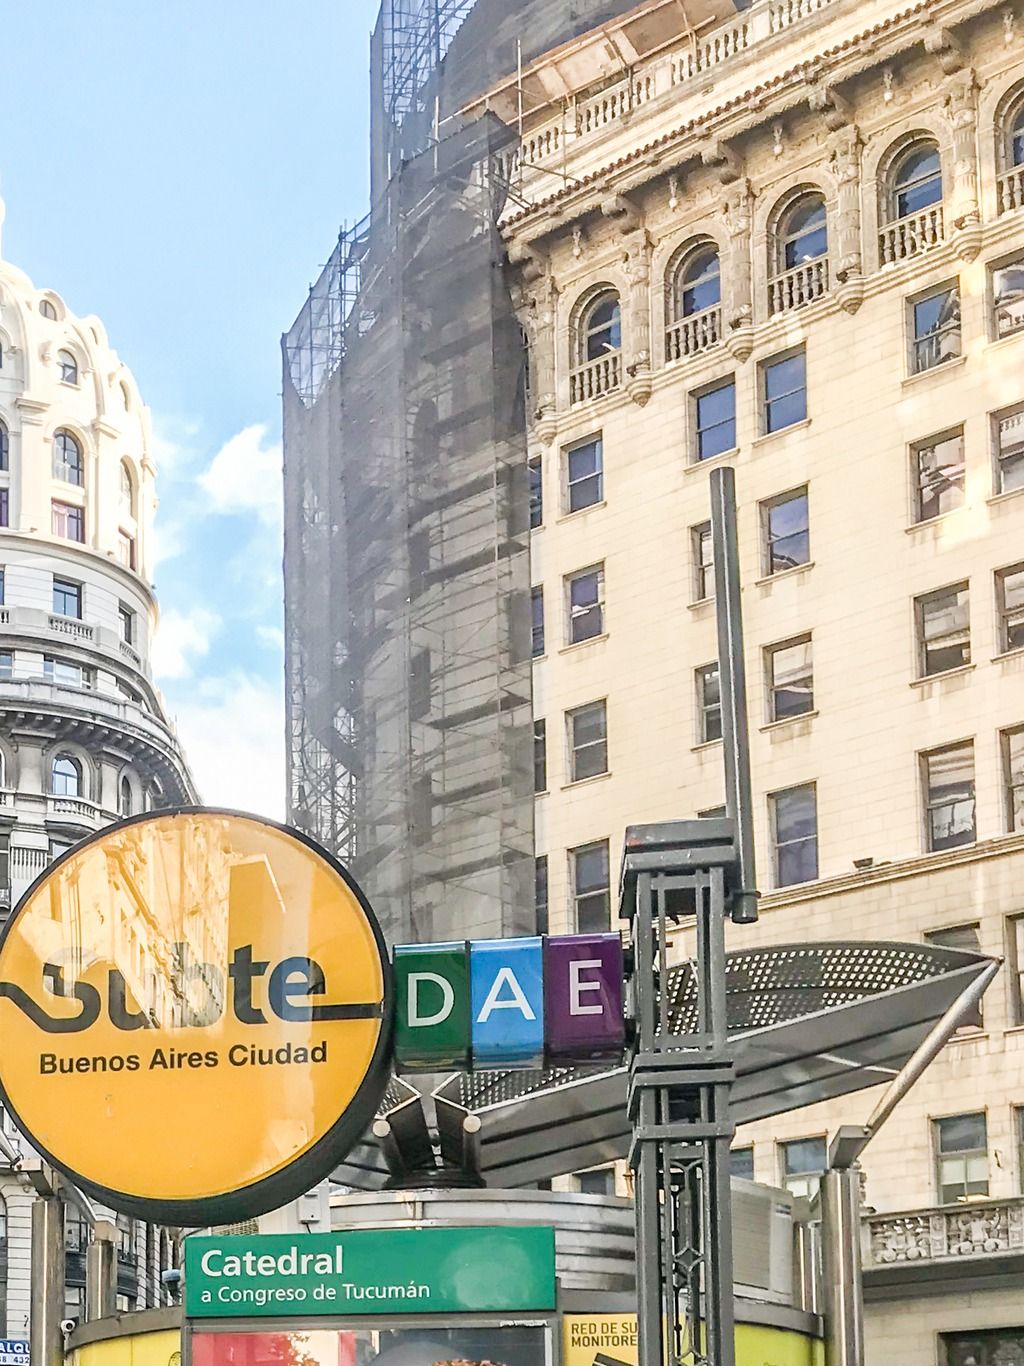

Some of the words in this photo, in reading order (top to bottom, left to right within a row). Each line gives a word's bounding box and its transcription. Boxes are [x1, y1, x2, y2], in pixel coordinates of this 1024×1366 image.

[42, 942, 326, 1033] Subte
[407, 972, 455, 1027] D
[476, 967, 537, 1023] A
[569, 959, 604, 1016] E
[39, 1051, 140, 1075] Buenos
[148, 1048, 219, 1070] Aires
[228, 1041, 328, 1067] Ciudad
[200, 1244, 344, 1277] Catedral
[201, 1291, 212, 1303] a
[217, 1286, 307, 1306] Congreso
[312, 1284, 336, 1300] de
[342, 1281, 430, 1300] Tucumán
[571, 1323, 597, 1335] RED
[601, 1322, 617, 1335] DE
[621, 1322, 638, 1335] SU
[571, 1335, 637, 1347] MONITORE
